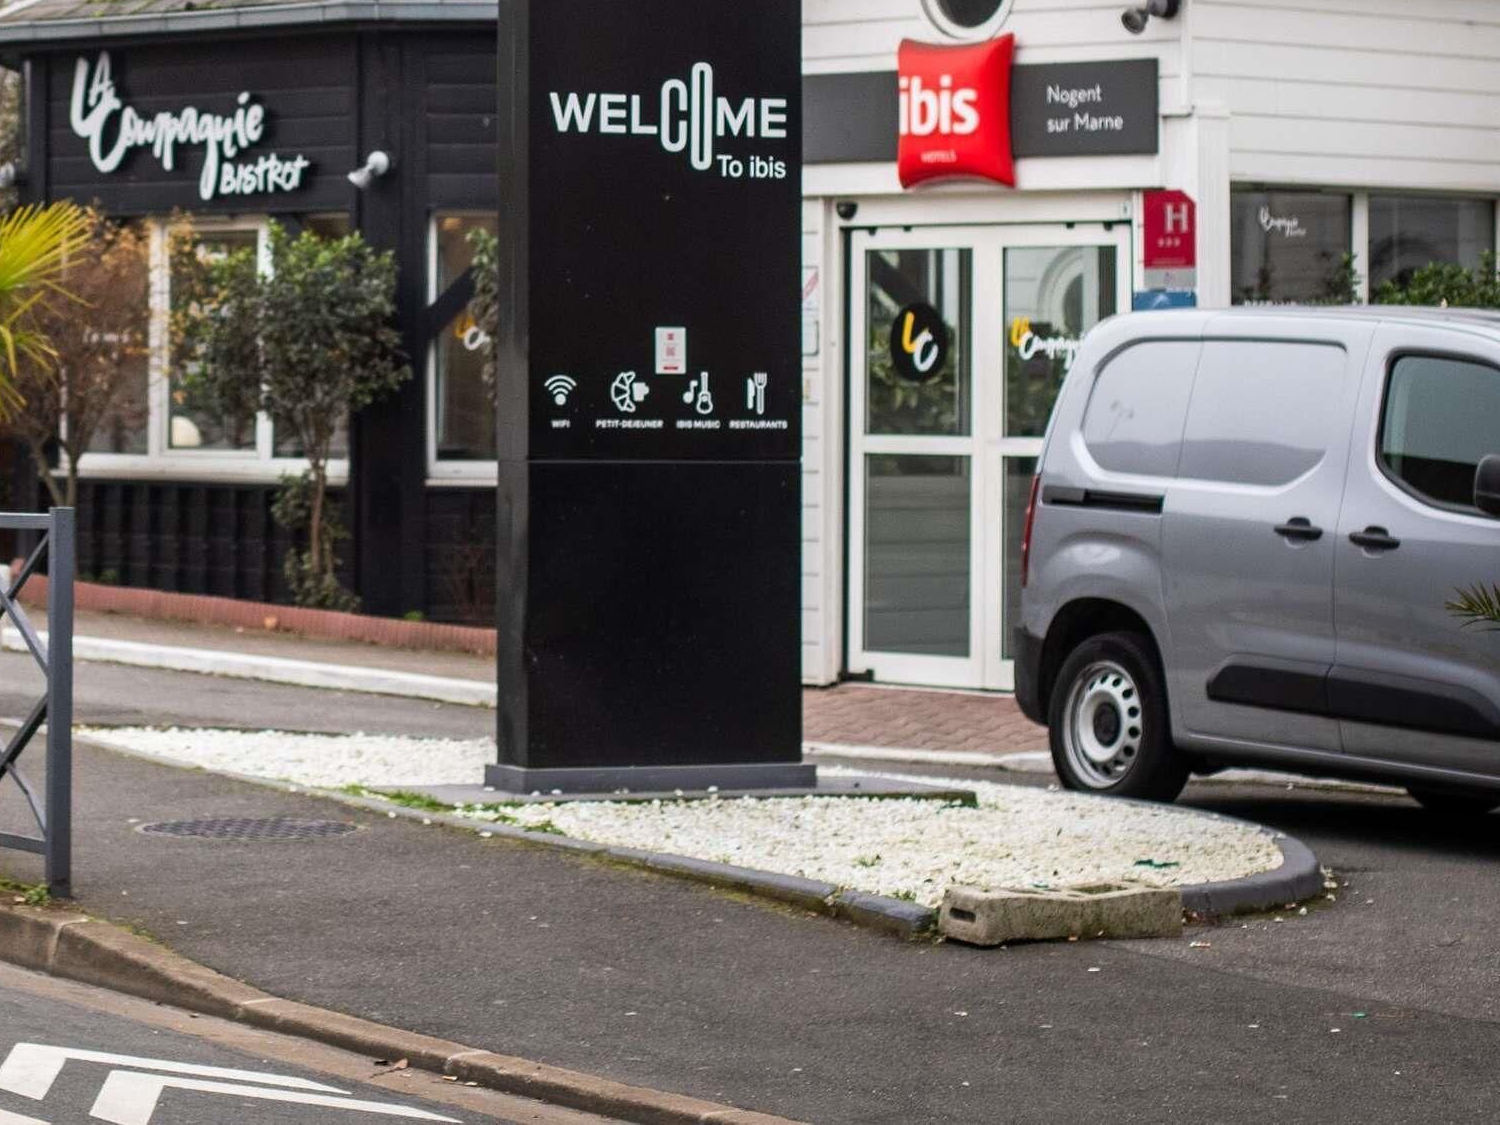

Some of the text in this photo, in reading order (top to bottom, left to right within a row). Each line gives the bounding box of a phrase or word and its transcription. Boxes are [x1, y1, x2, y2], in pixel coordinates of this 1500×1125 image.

[899, 74, 980, 136] ibis
[1046, 83, 1102, 108] Nogent
[550, 62, 788, 171] WELCOME
[1046, 112, 1124, 133] sur Marne
[88, 91, 265, 201] Compagnie
[716, 155, 787, 178] To ibis
[1165, 203, 1188, 234] H
